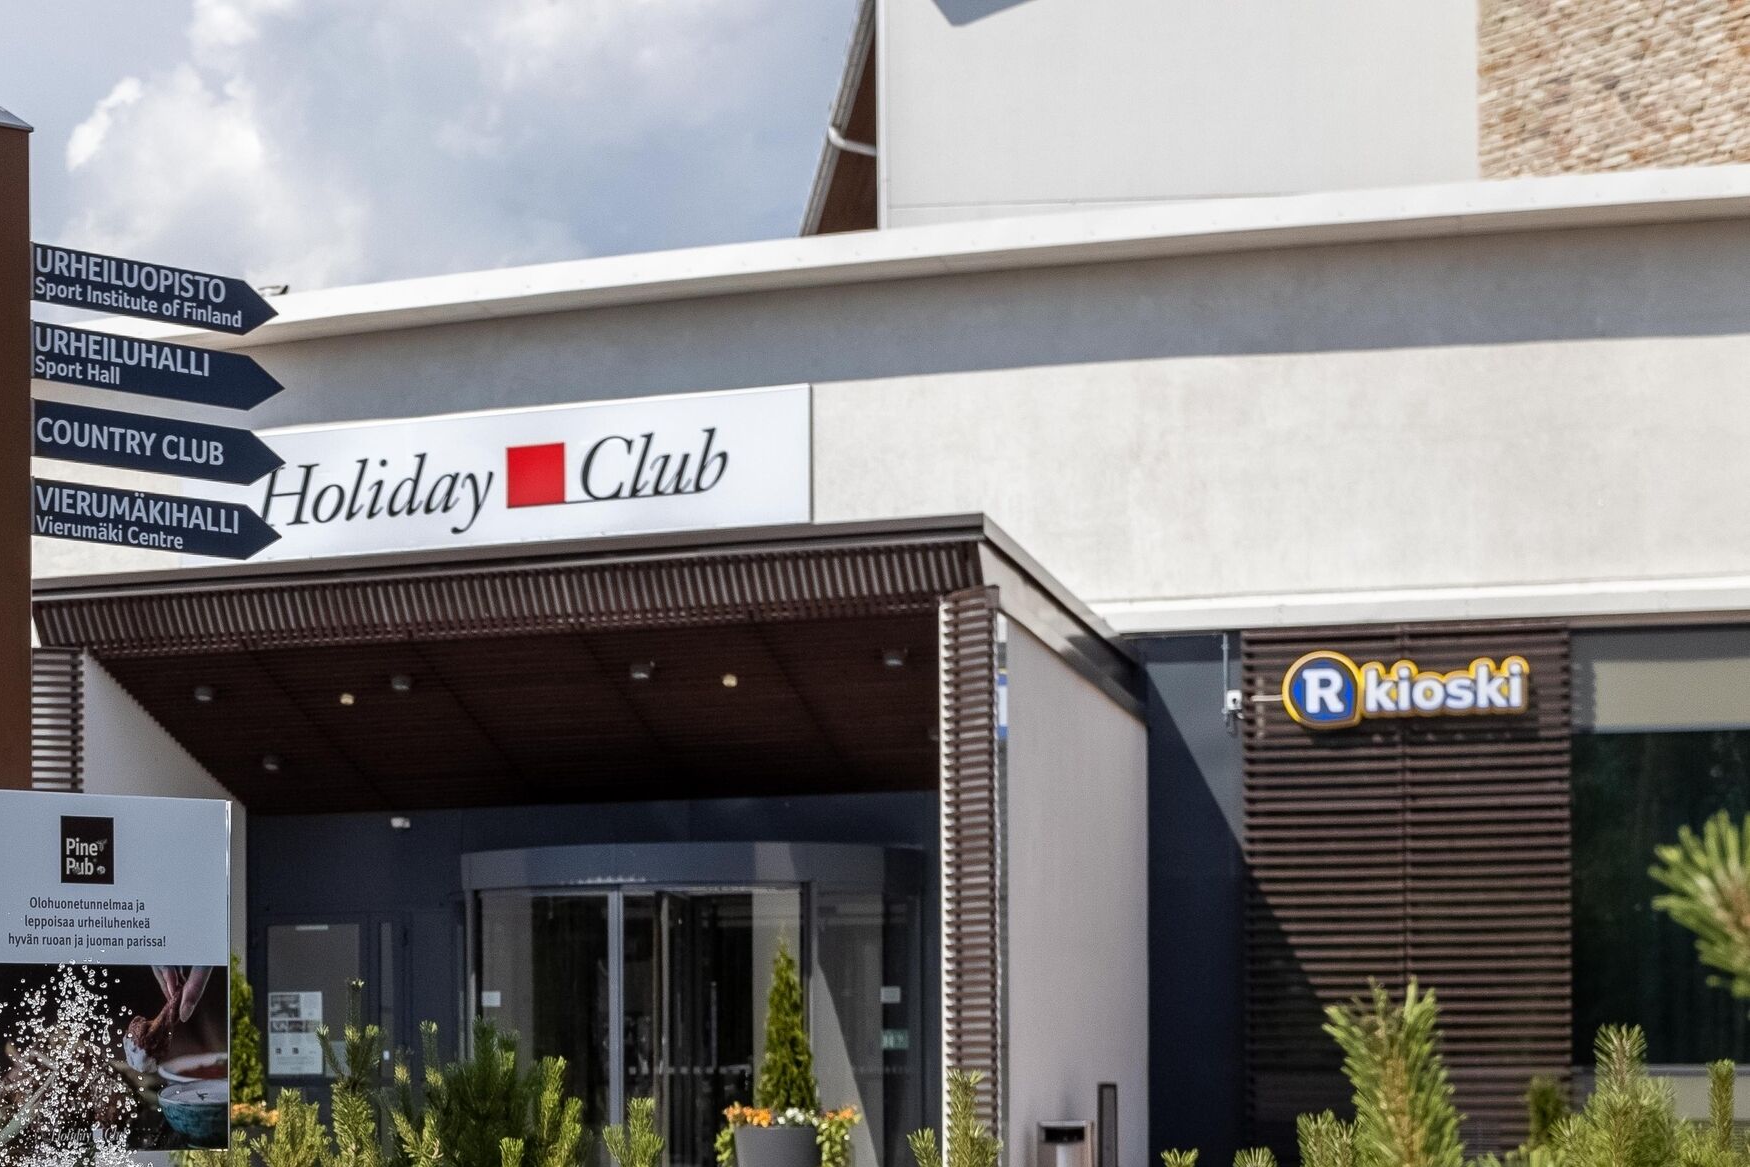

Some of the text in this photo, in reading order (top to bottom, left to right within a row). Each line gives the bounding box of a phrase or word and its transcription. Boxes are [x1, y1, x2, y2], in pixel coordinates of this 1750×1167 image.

[35, 247, 226, 303] URHEILUOPISTO
[35, 276, 243, 328] Sport Institute of Finland
[35, 326, 210, 377] URHEILUHALLI
[35, 355, 120, 385] Sport Hall
[36, 417, 225, 466] COUNTRY CLUB
[261, 427, 730, 535] Holiday Club
[35, 485, 240, 535] VIERUMÄKIHALLI
[36, 514, 184, 550] Vierumäki Centre
[66, 837, 99, 857] Pine
[66, 857, 94, 875] Pub
[24, 915, 151, 930] leppoisaa urheiluhenkeä
[29, 896, 145, 913] Olohuonetunnelmaa ja
[8, 933, 167, 949] hyvän ruoan ja juoman parissa!
